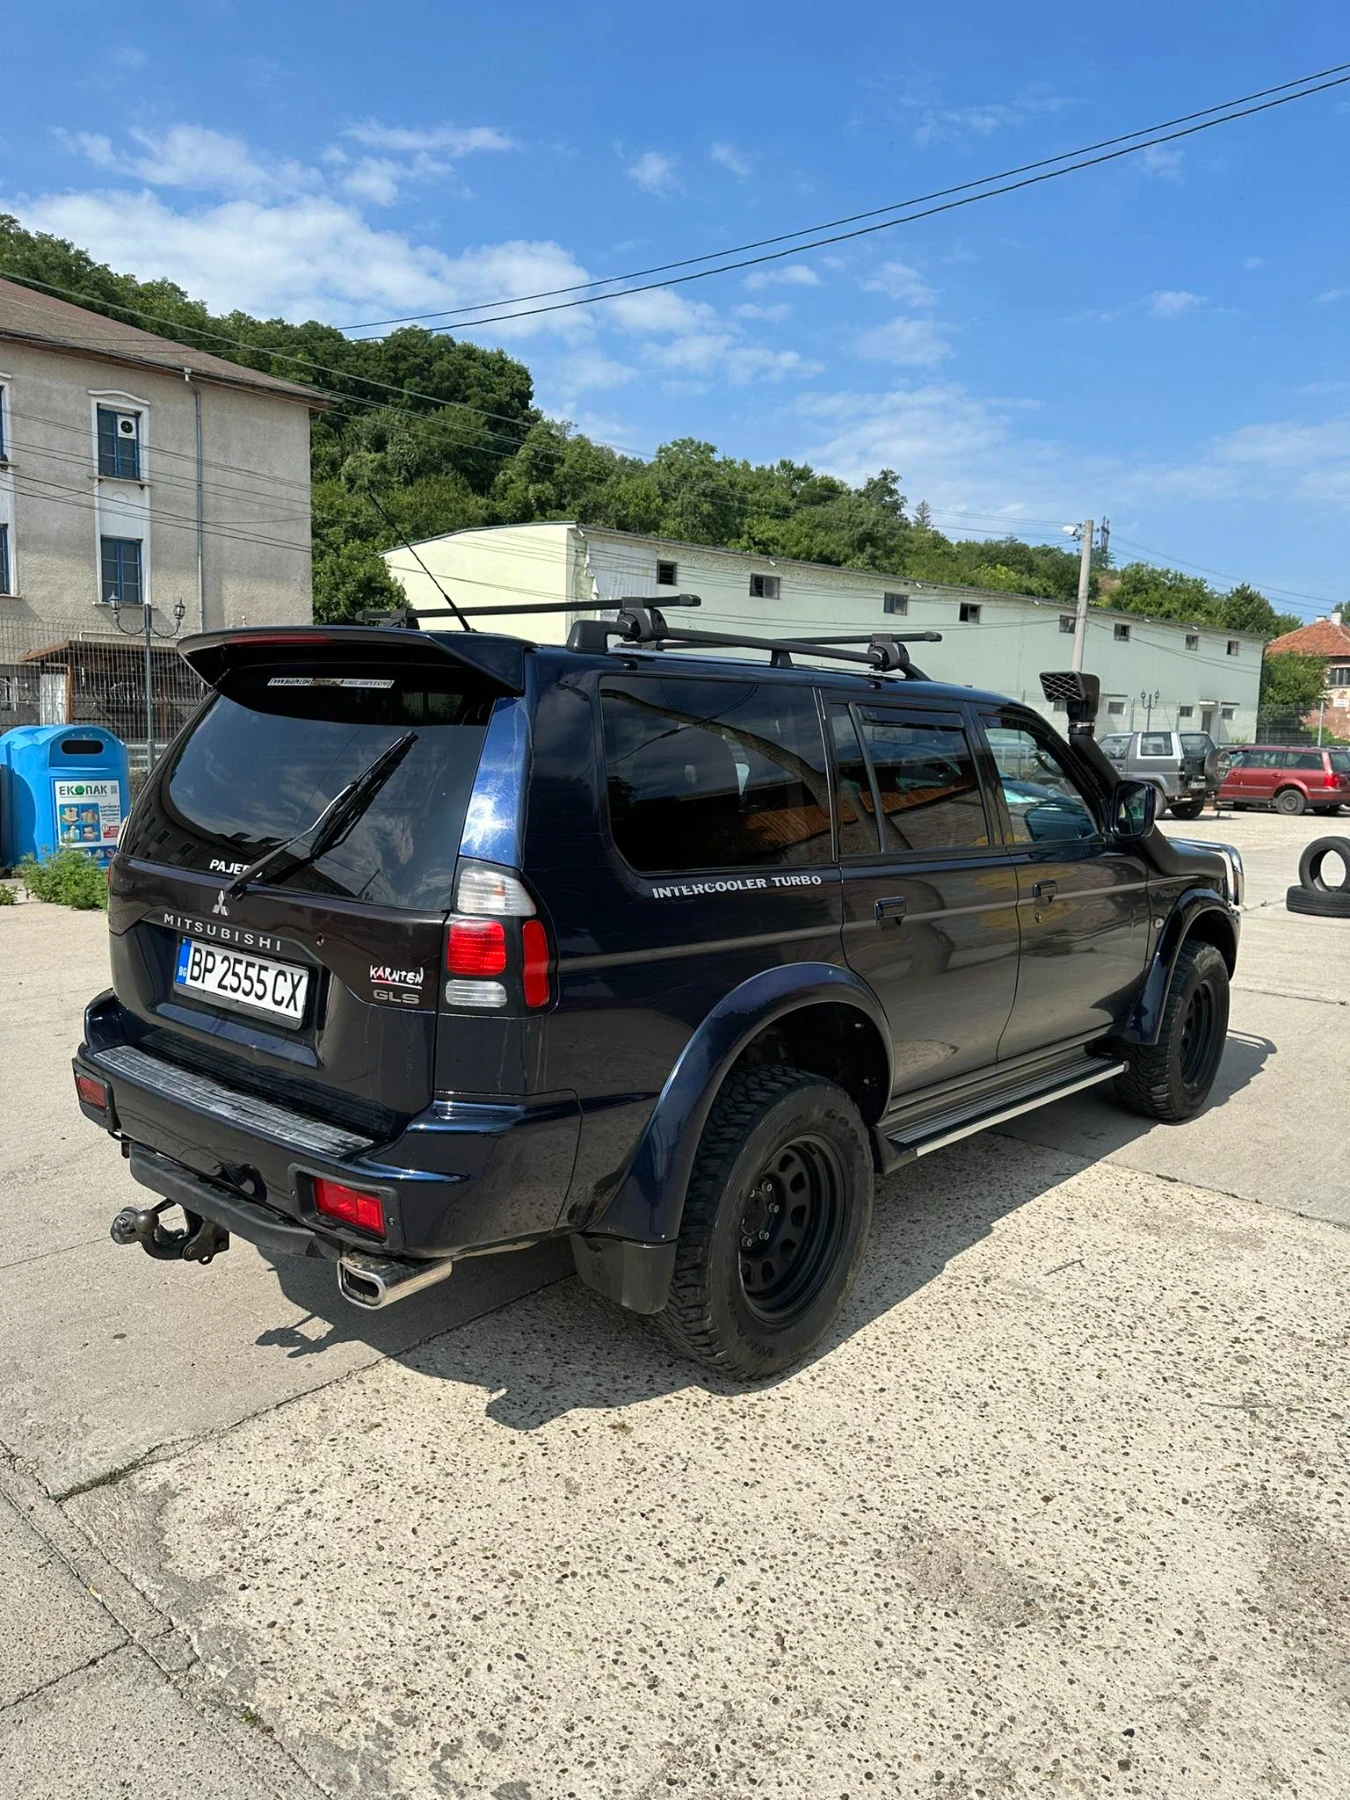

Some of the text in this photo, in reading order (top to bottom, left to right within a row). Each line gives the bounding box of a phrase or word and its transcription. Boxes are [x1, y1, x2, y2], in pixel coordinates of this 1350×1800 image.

[209, 858, 263, 878] PAJE
[652, 875, 822, 899] INTERCOOLER TURBO
[164, 913, 282, 951] MITSUBISHI
[178, 966, 188, 978] BG
[189, 947, 304, 1012] BP 2555 CX
[373, 989, 420, 1005] GLS
